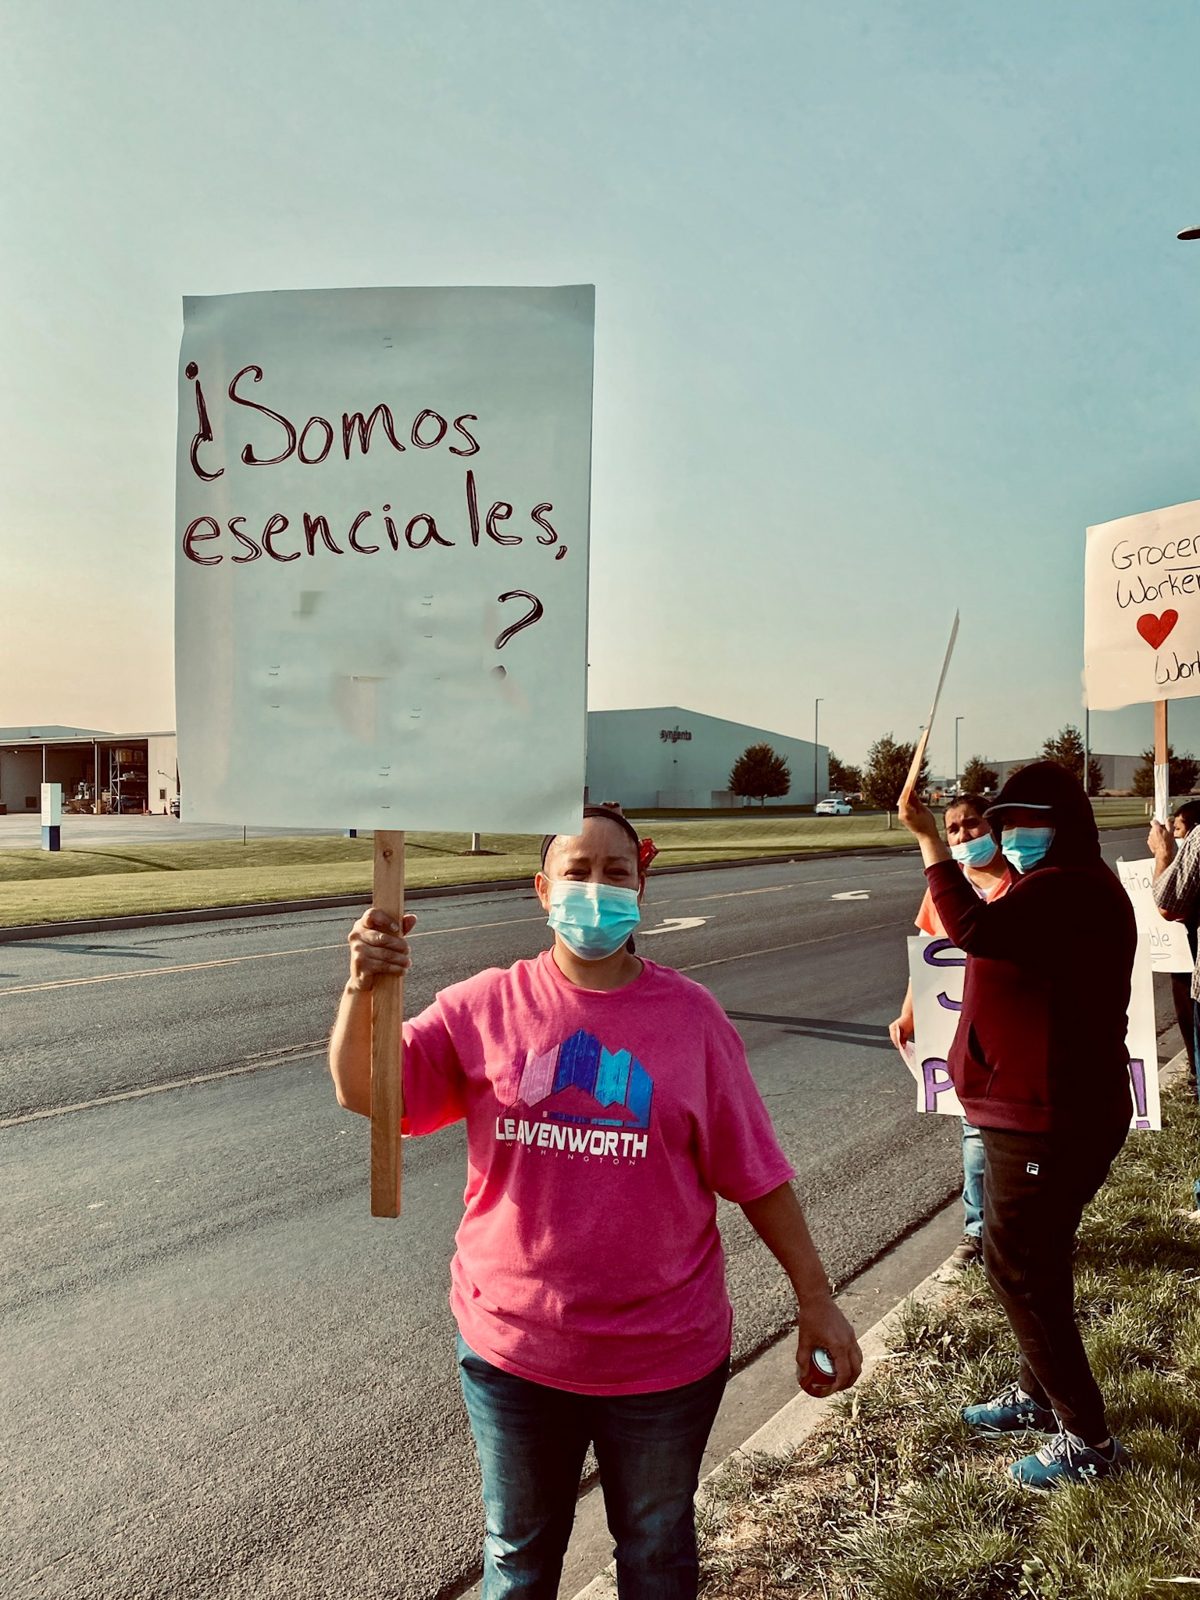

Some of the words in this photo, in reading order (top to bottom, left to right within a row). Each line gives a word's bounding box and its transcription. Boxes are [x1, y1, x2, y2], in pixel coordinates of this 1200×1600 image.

[185, 361, 480, 482] ¿Somos
[182, 469, 568, 566] esenciales,
[495, 1116, 648, 1159] LEAVENWORTH
[505, 1141, 636, 1166] WSHINGTON
